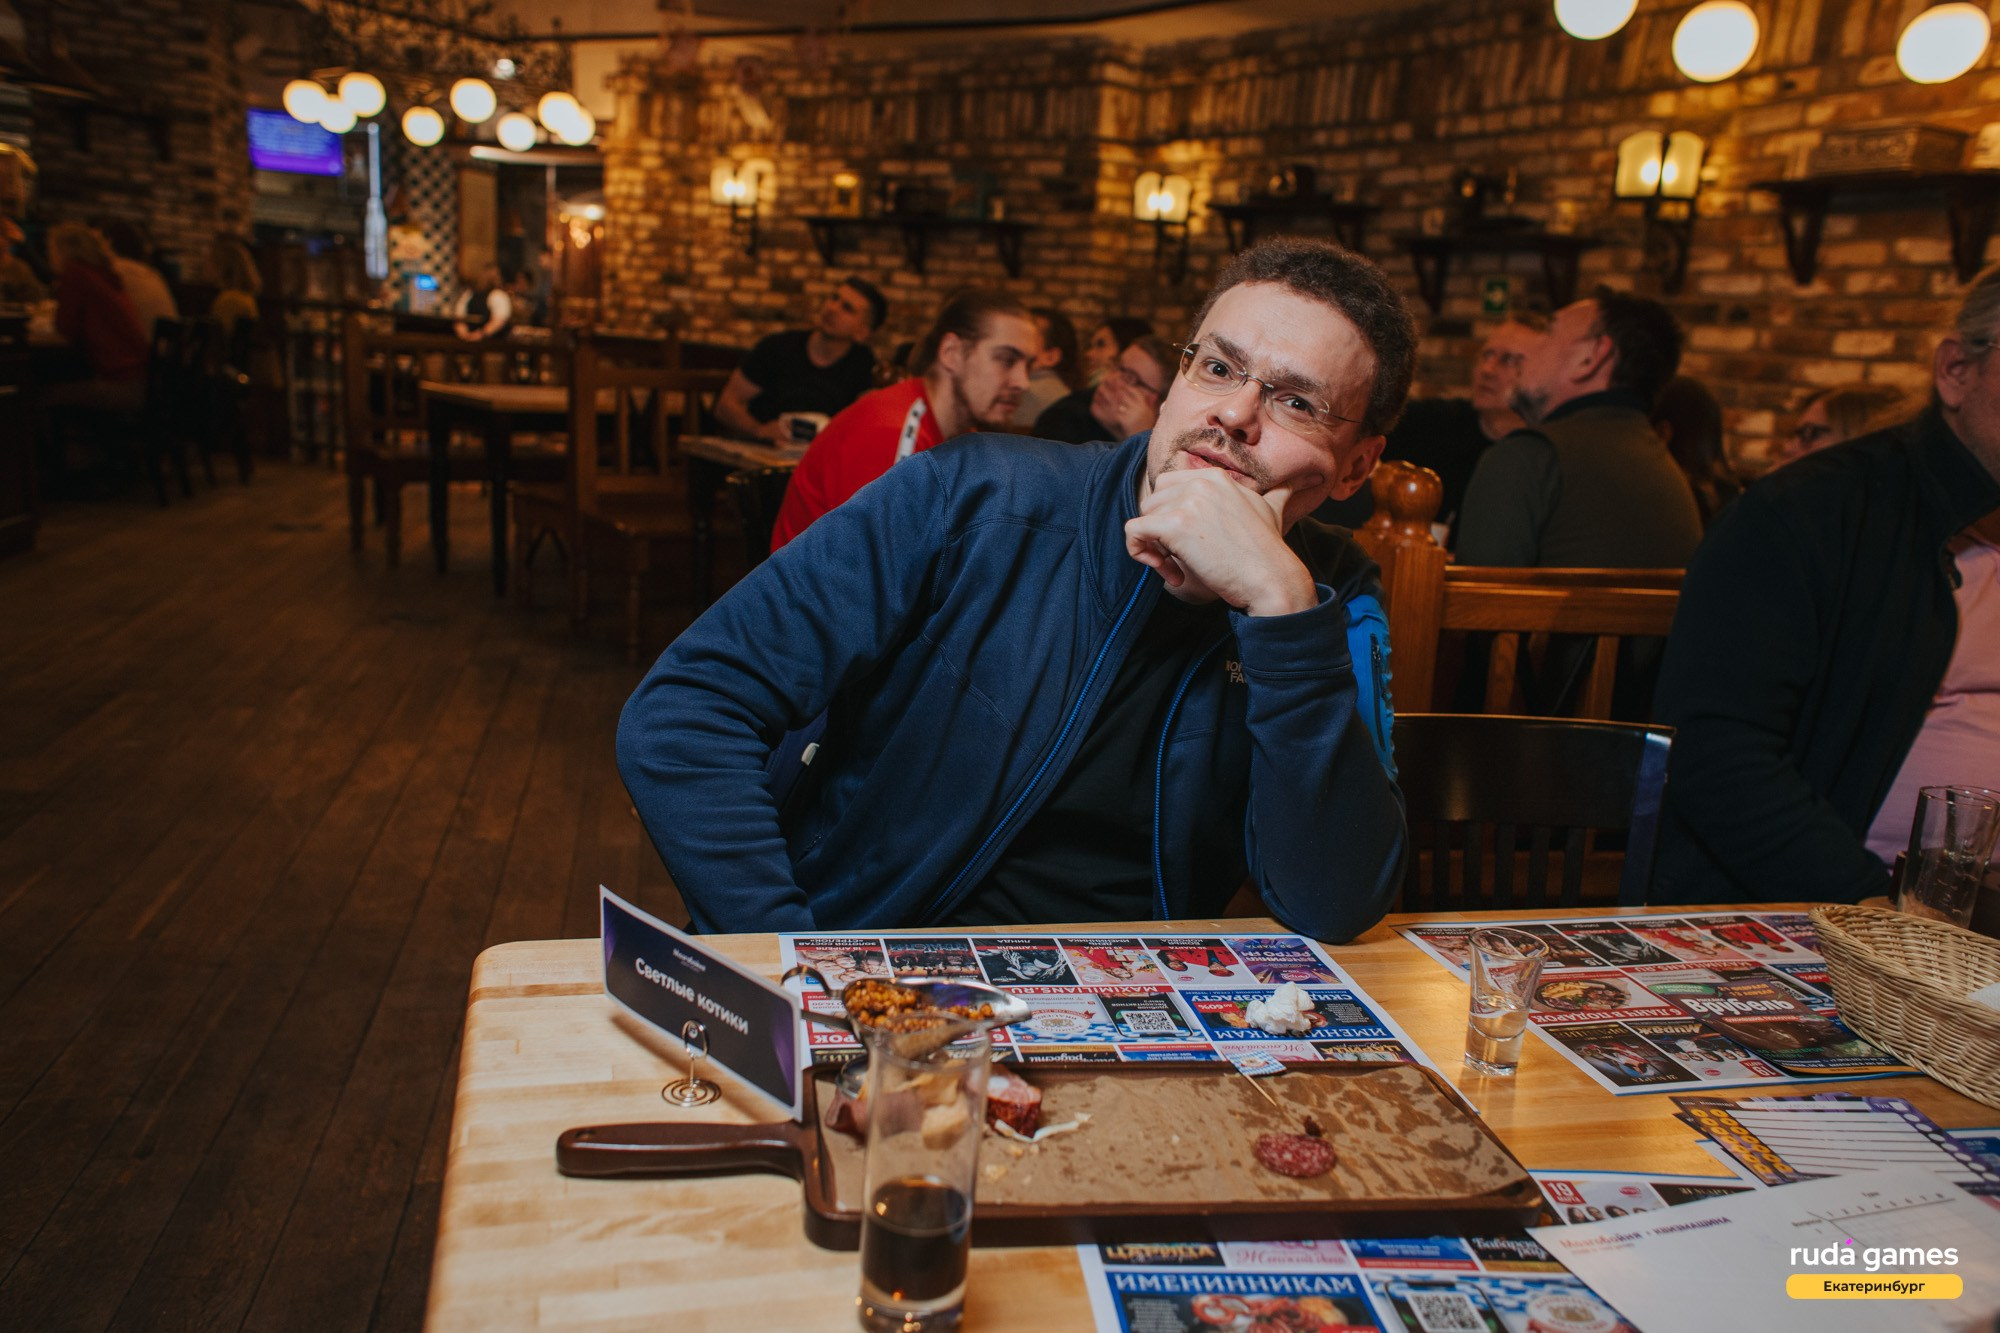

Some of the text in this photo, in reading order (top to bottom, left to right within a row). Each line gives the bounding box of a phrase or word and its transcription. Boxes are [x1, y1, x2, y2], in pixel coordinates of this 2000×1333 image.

[635, 957, 749, 1035] Светлые котики
[1010, 986, 1158, 994] MAXIMILIANS.RU
[1680, 998, 1795, 1016] Врубель
[1319, 1043, 1401, 1055] ЦАРИЦА
[1547, 1181, 1574, 1197] 19
[1114, 1273, 1356, 1294] ИМЕНИННИКАМ
